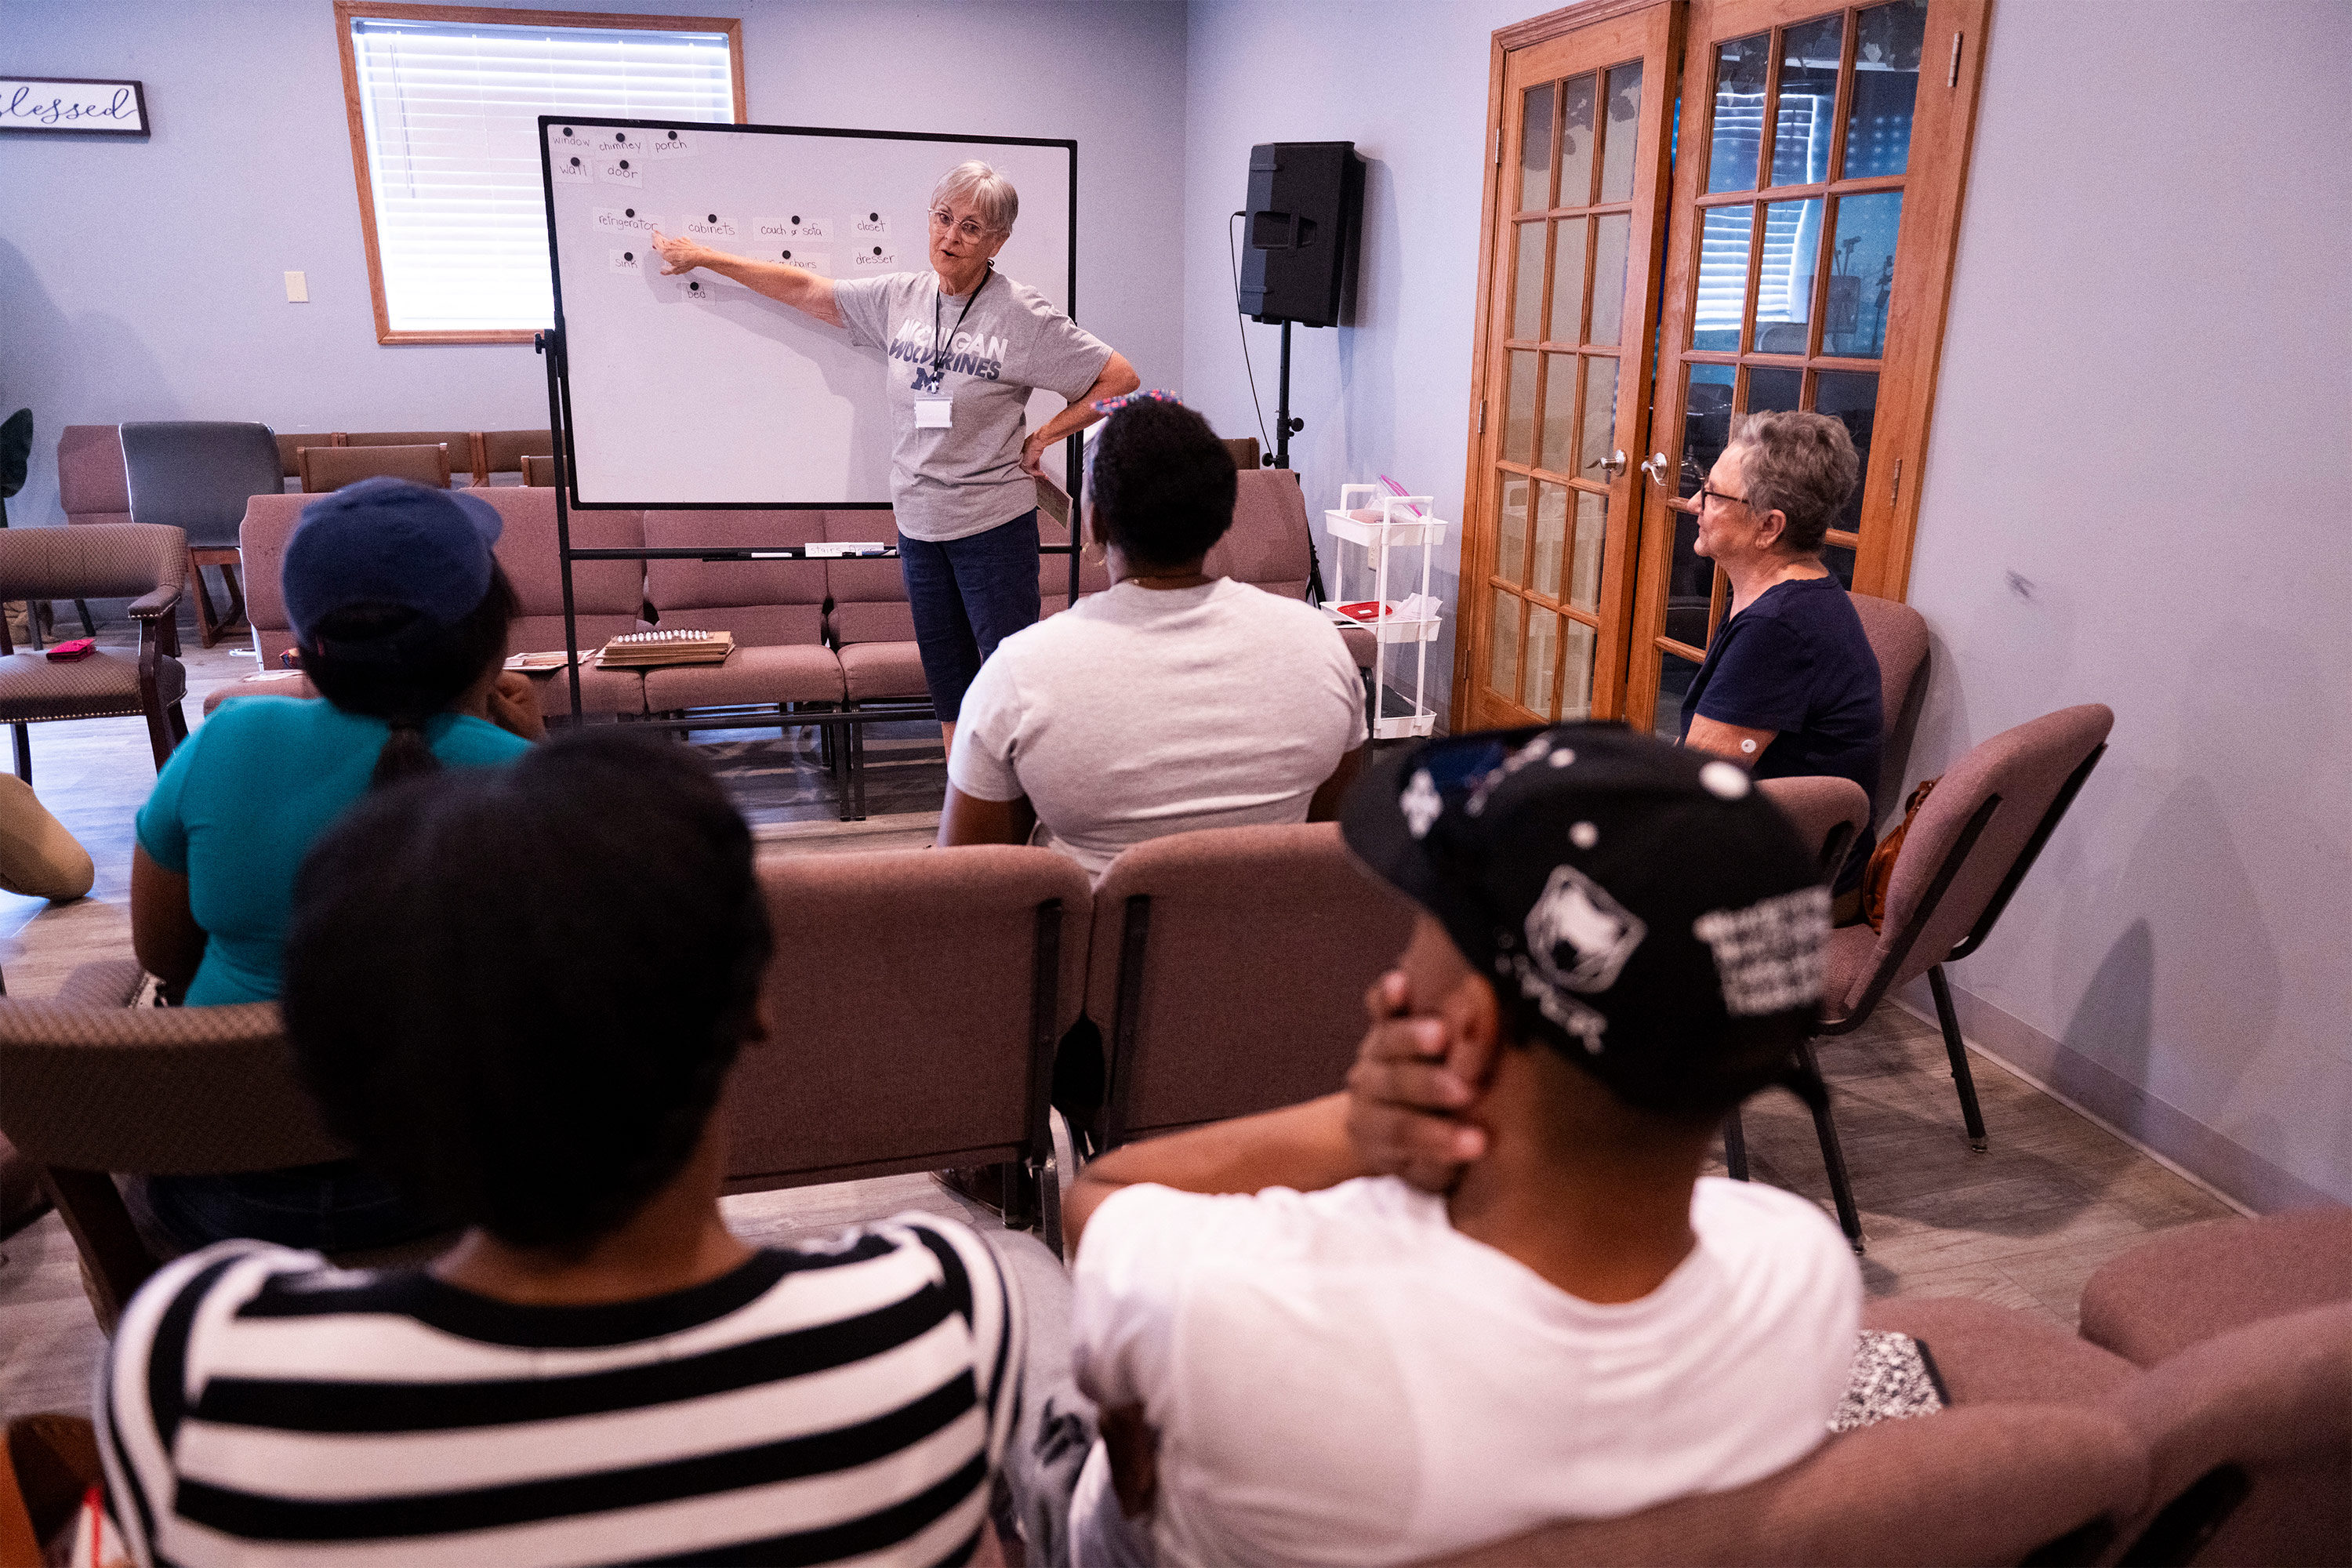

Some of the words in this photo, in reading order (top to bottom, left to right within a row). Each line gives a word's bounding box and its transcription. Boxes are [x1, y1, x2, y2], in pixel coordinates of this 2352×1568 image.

[0, 86, 138, 124] lessed
[552, 135, 590, 147] window
[599, 141, 642, 154] chimney
[655, 140, 688, 154] porch
[608, 165, 639, 179] door
[598, 212, 659, 230] refrigerator
[857, 220, 886, 232] closet
[688, 222, 735, 235] cabinets
[760, 224, 787, 235] couch
[802, 223, 822, 236] sofa
[856, 252, 895, 264] dresser
[686, 286, 706, 299] bed
[810, 545, 842, 554] stairs
